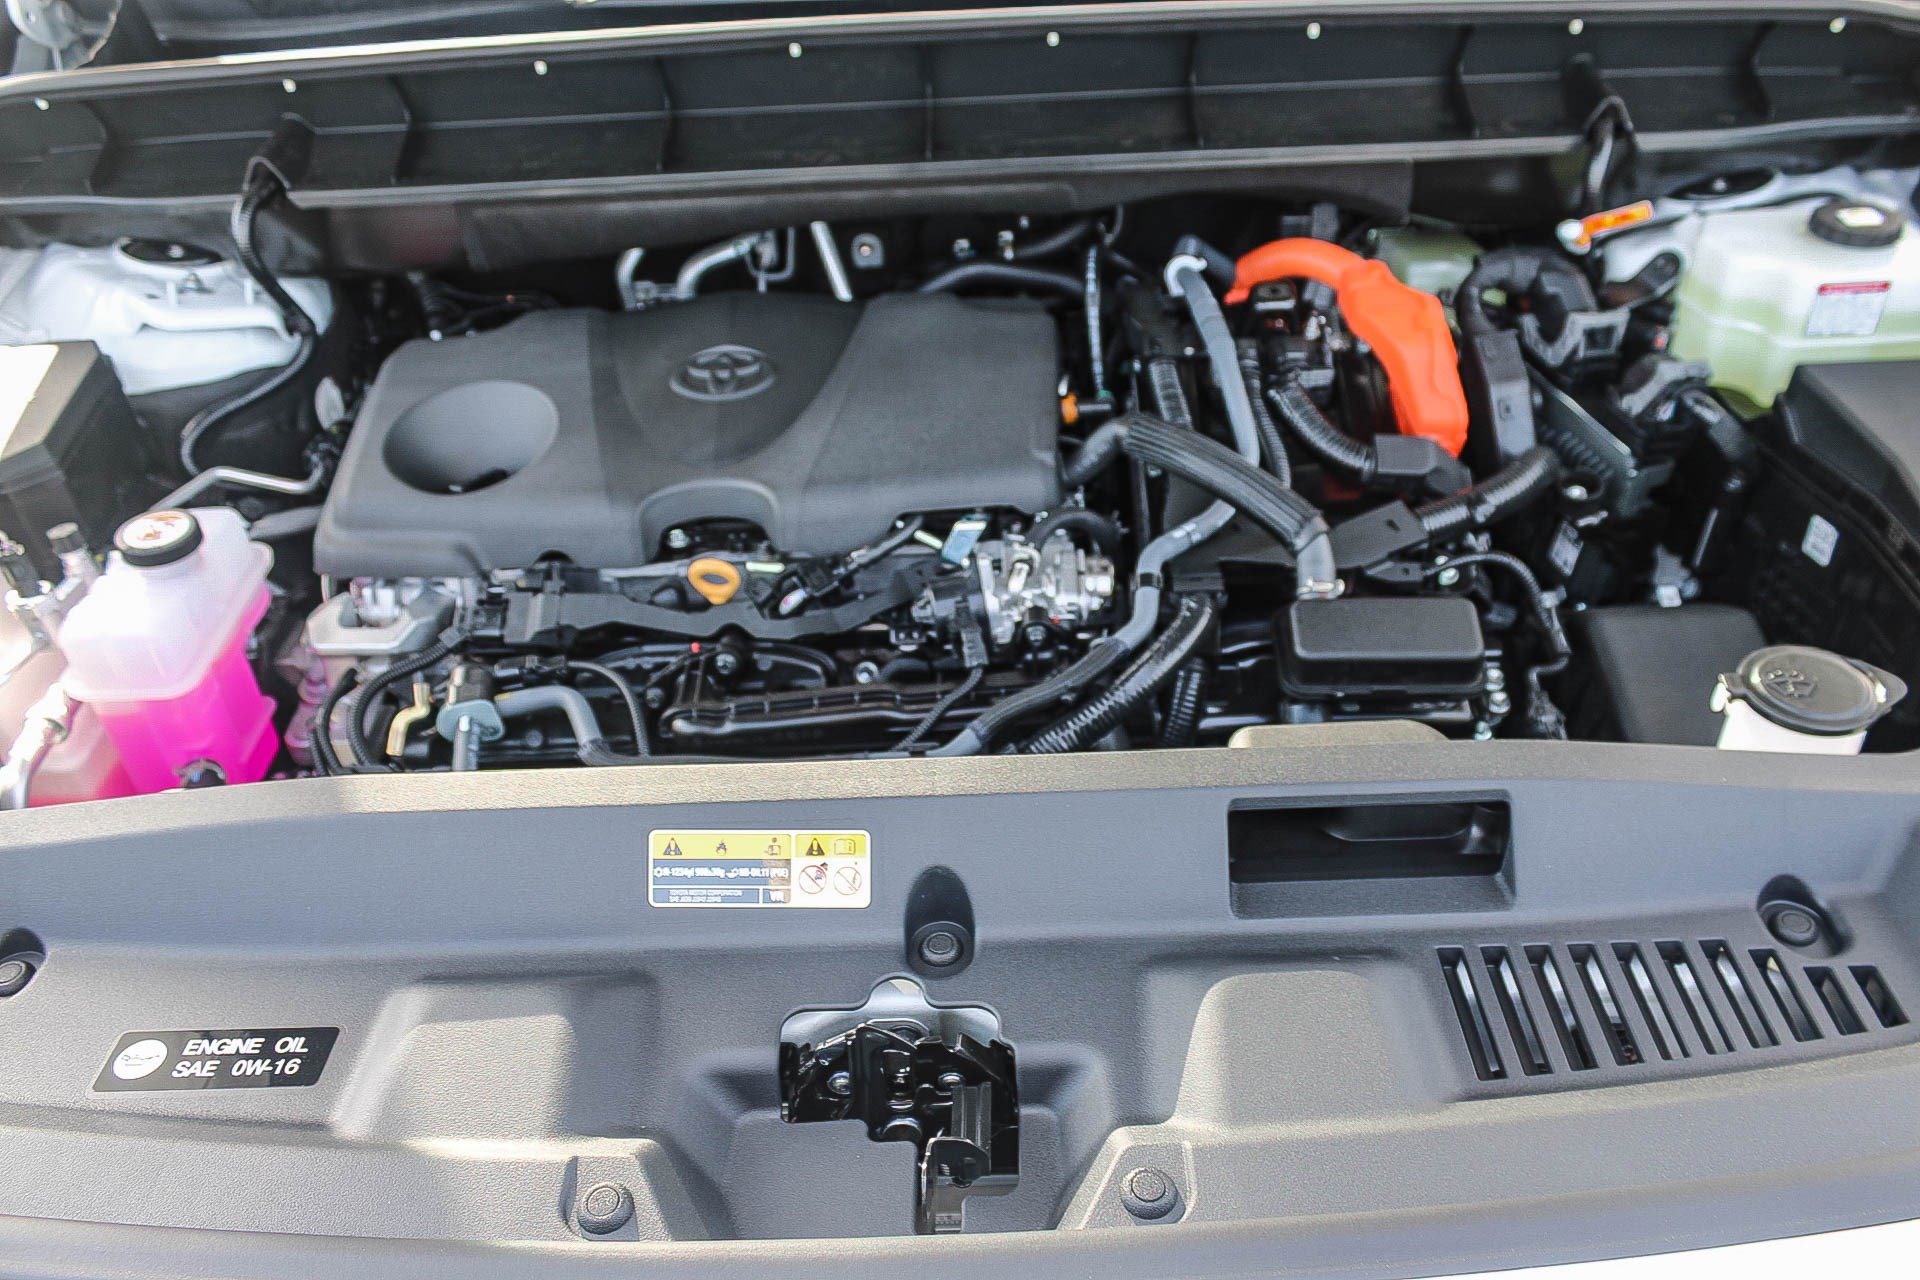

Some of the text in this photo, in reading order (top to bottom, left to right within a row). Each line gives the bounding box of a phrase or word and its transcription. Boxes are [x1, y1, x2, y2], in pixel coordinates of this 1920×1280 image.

[182, 1037, 309, 1056] ENGINE OIL
[171, 1058, 302, 1078] SAE 0W-16
